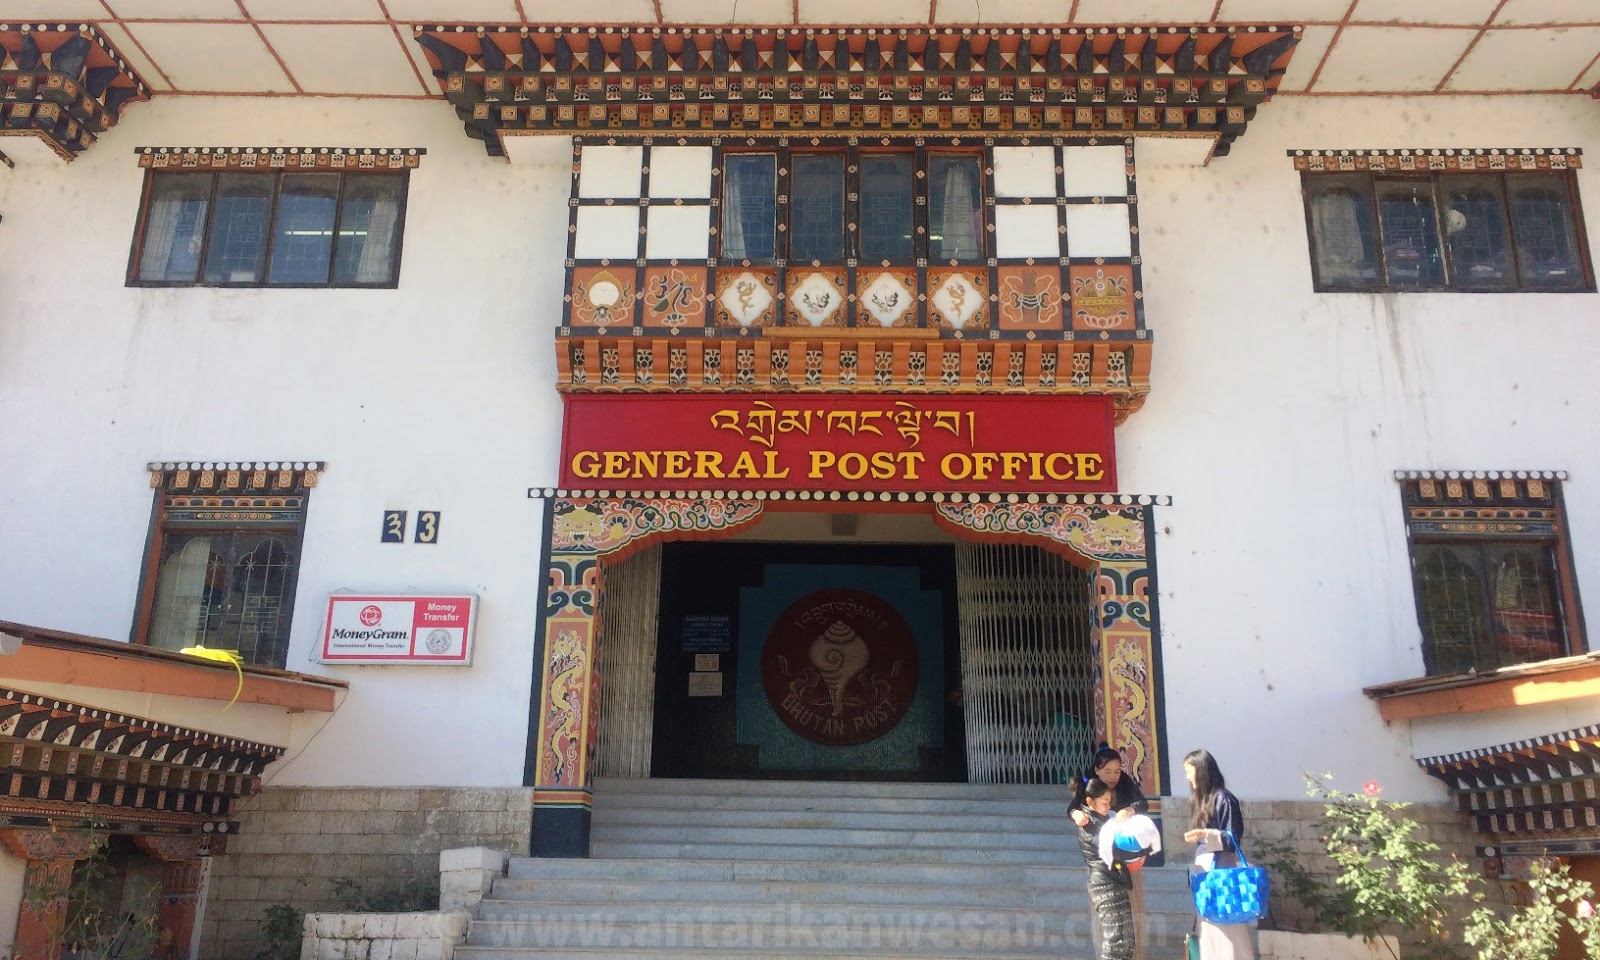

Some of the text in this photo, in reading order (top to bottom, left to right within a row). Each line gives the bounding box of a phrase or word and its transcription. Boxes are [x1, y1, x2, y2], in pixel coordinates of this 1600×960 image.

[571, 449, 1105, 482] GENERAL POST OFFICE
[419, 512, 436, 542] 3
[423, 613, 460, 622] Transfer
[427, 603, 457, 612] Money
[332, 628, 407, 641] MoneyGram
[781, 692, 897, 736] BHUTAN POST
